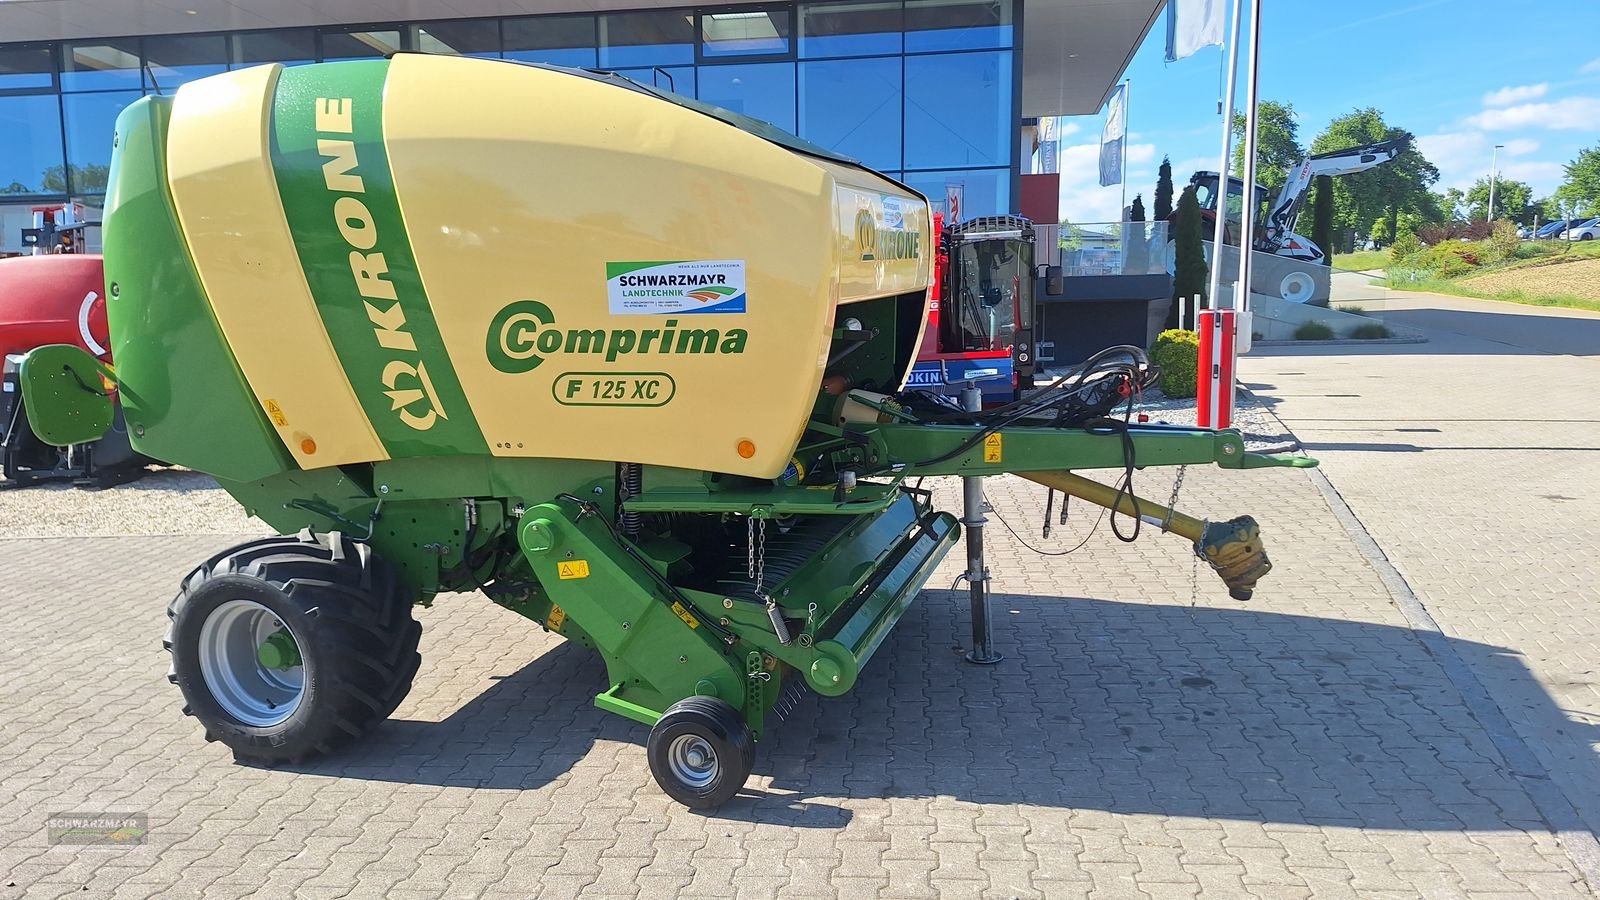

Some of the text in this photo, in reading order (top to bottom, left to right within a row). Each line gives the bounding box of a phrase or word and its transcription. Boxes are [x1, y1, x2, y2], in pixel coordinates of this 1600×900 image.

[315, 96, 418, 352] KRONE
[878, 230, 920, 261] KRONE
[619, 274, 726, 287] SCHWARZMAYR
[622, 289, 684, 298] LANDTECHNIK
[566, 380, 660, 399] F 125 XC
